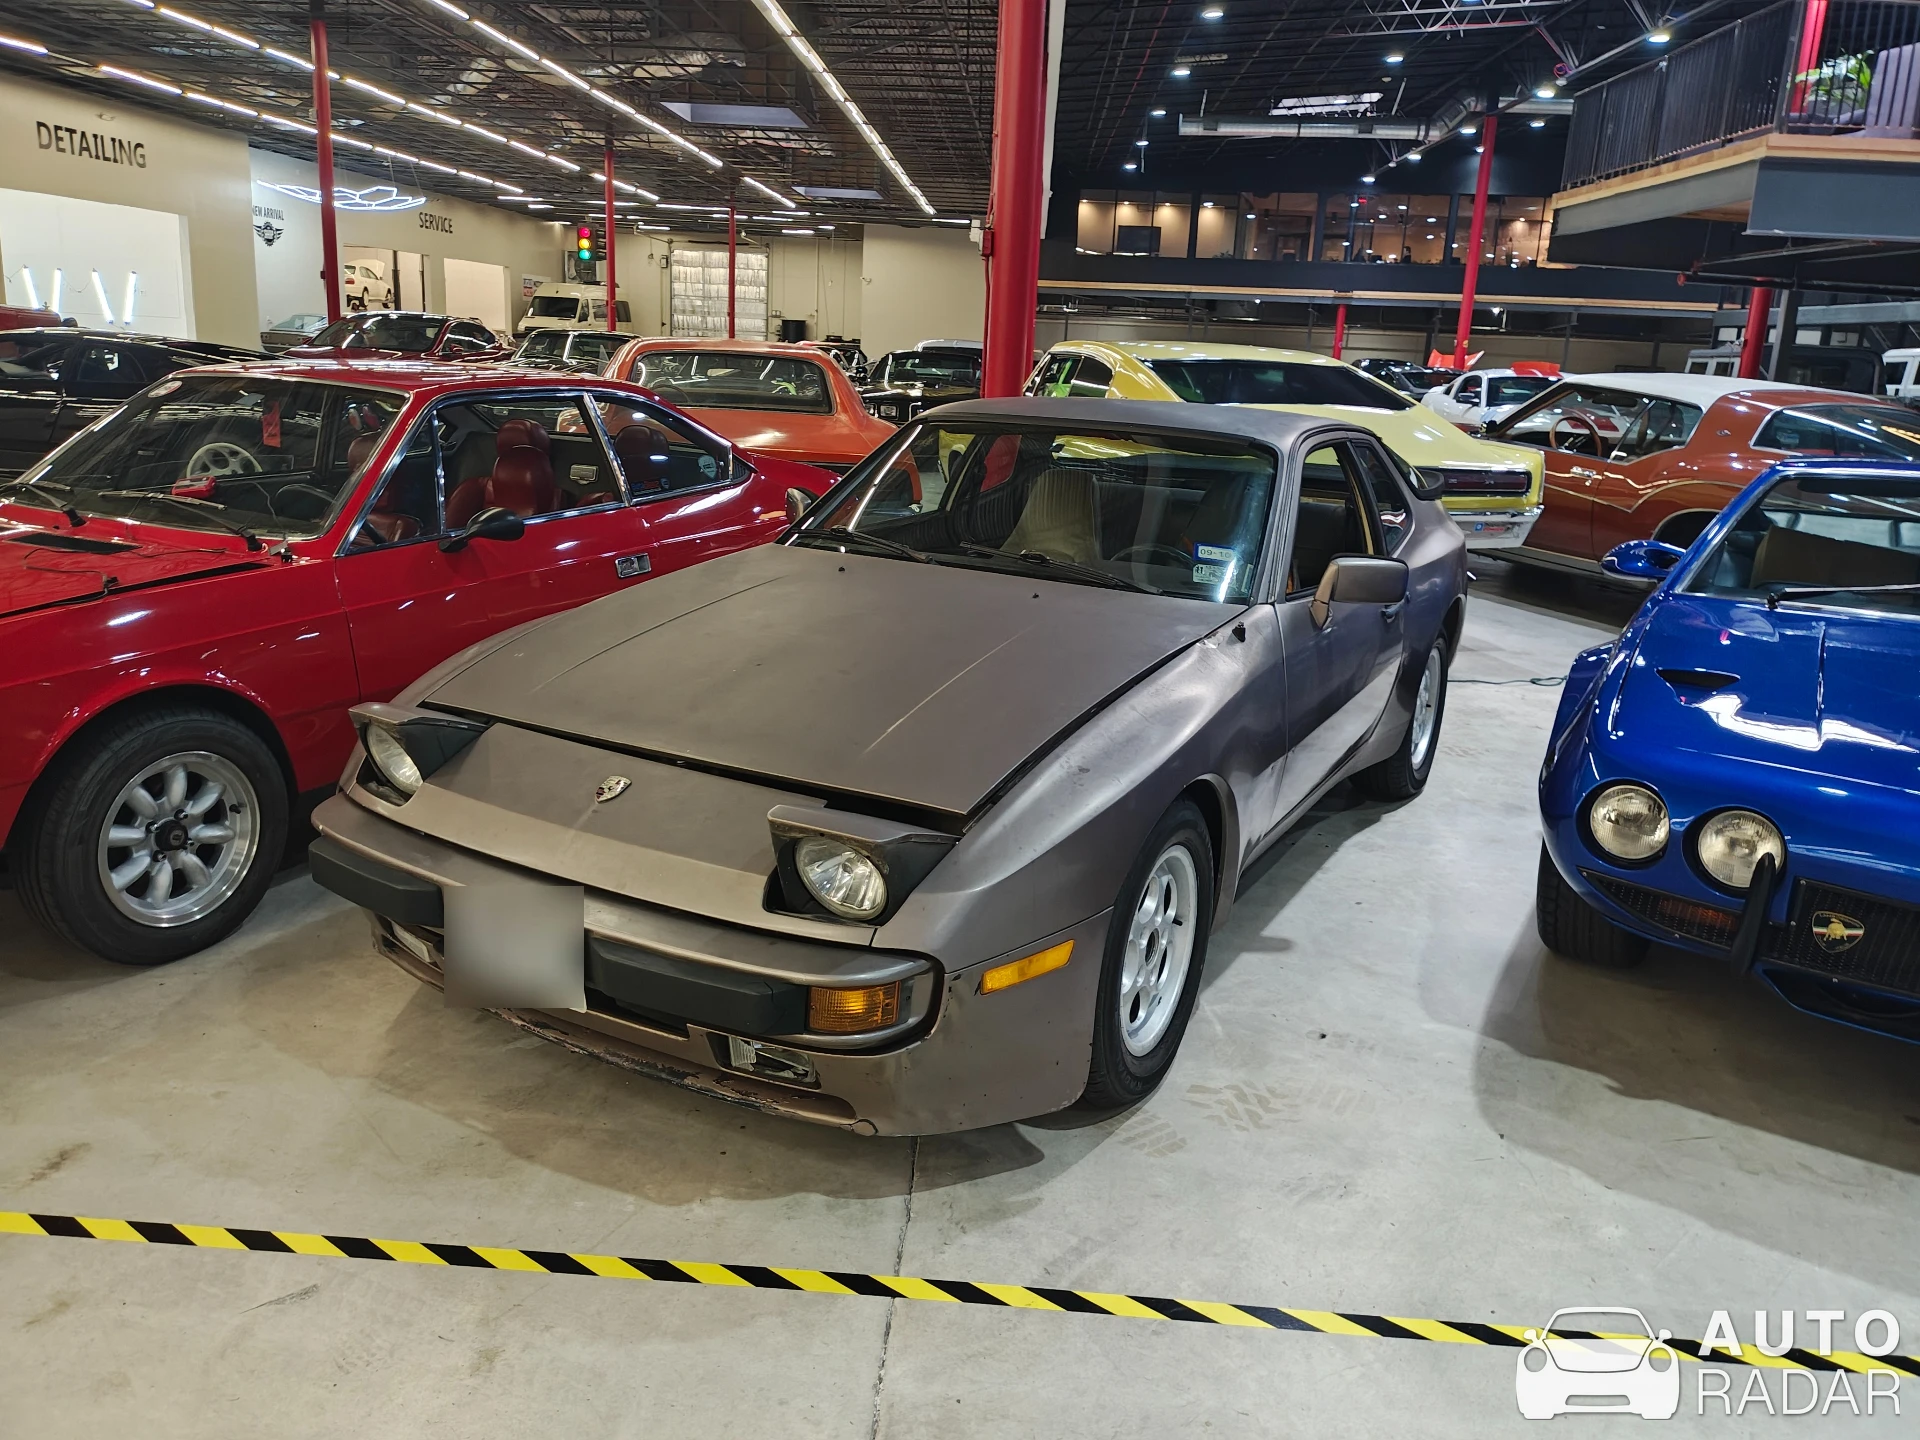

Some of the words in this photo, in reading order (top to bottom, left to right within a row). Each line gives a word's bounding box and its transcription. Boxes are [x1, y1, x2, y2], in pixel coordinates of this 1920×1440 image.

[36, 120, 147, 168] DETAILING
[263, 207, 284, 220] ARRIVAL
[419, 212, 453, 234] SERVICE
